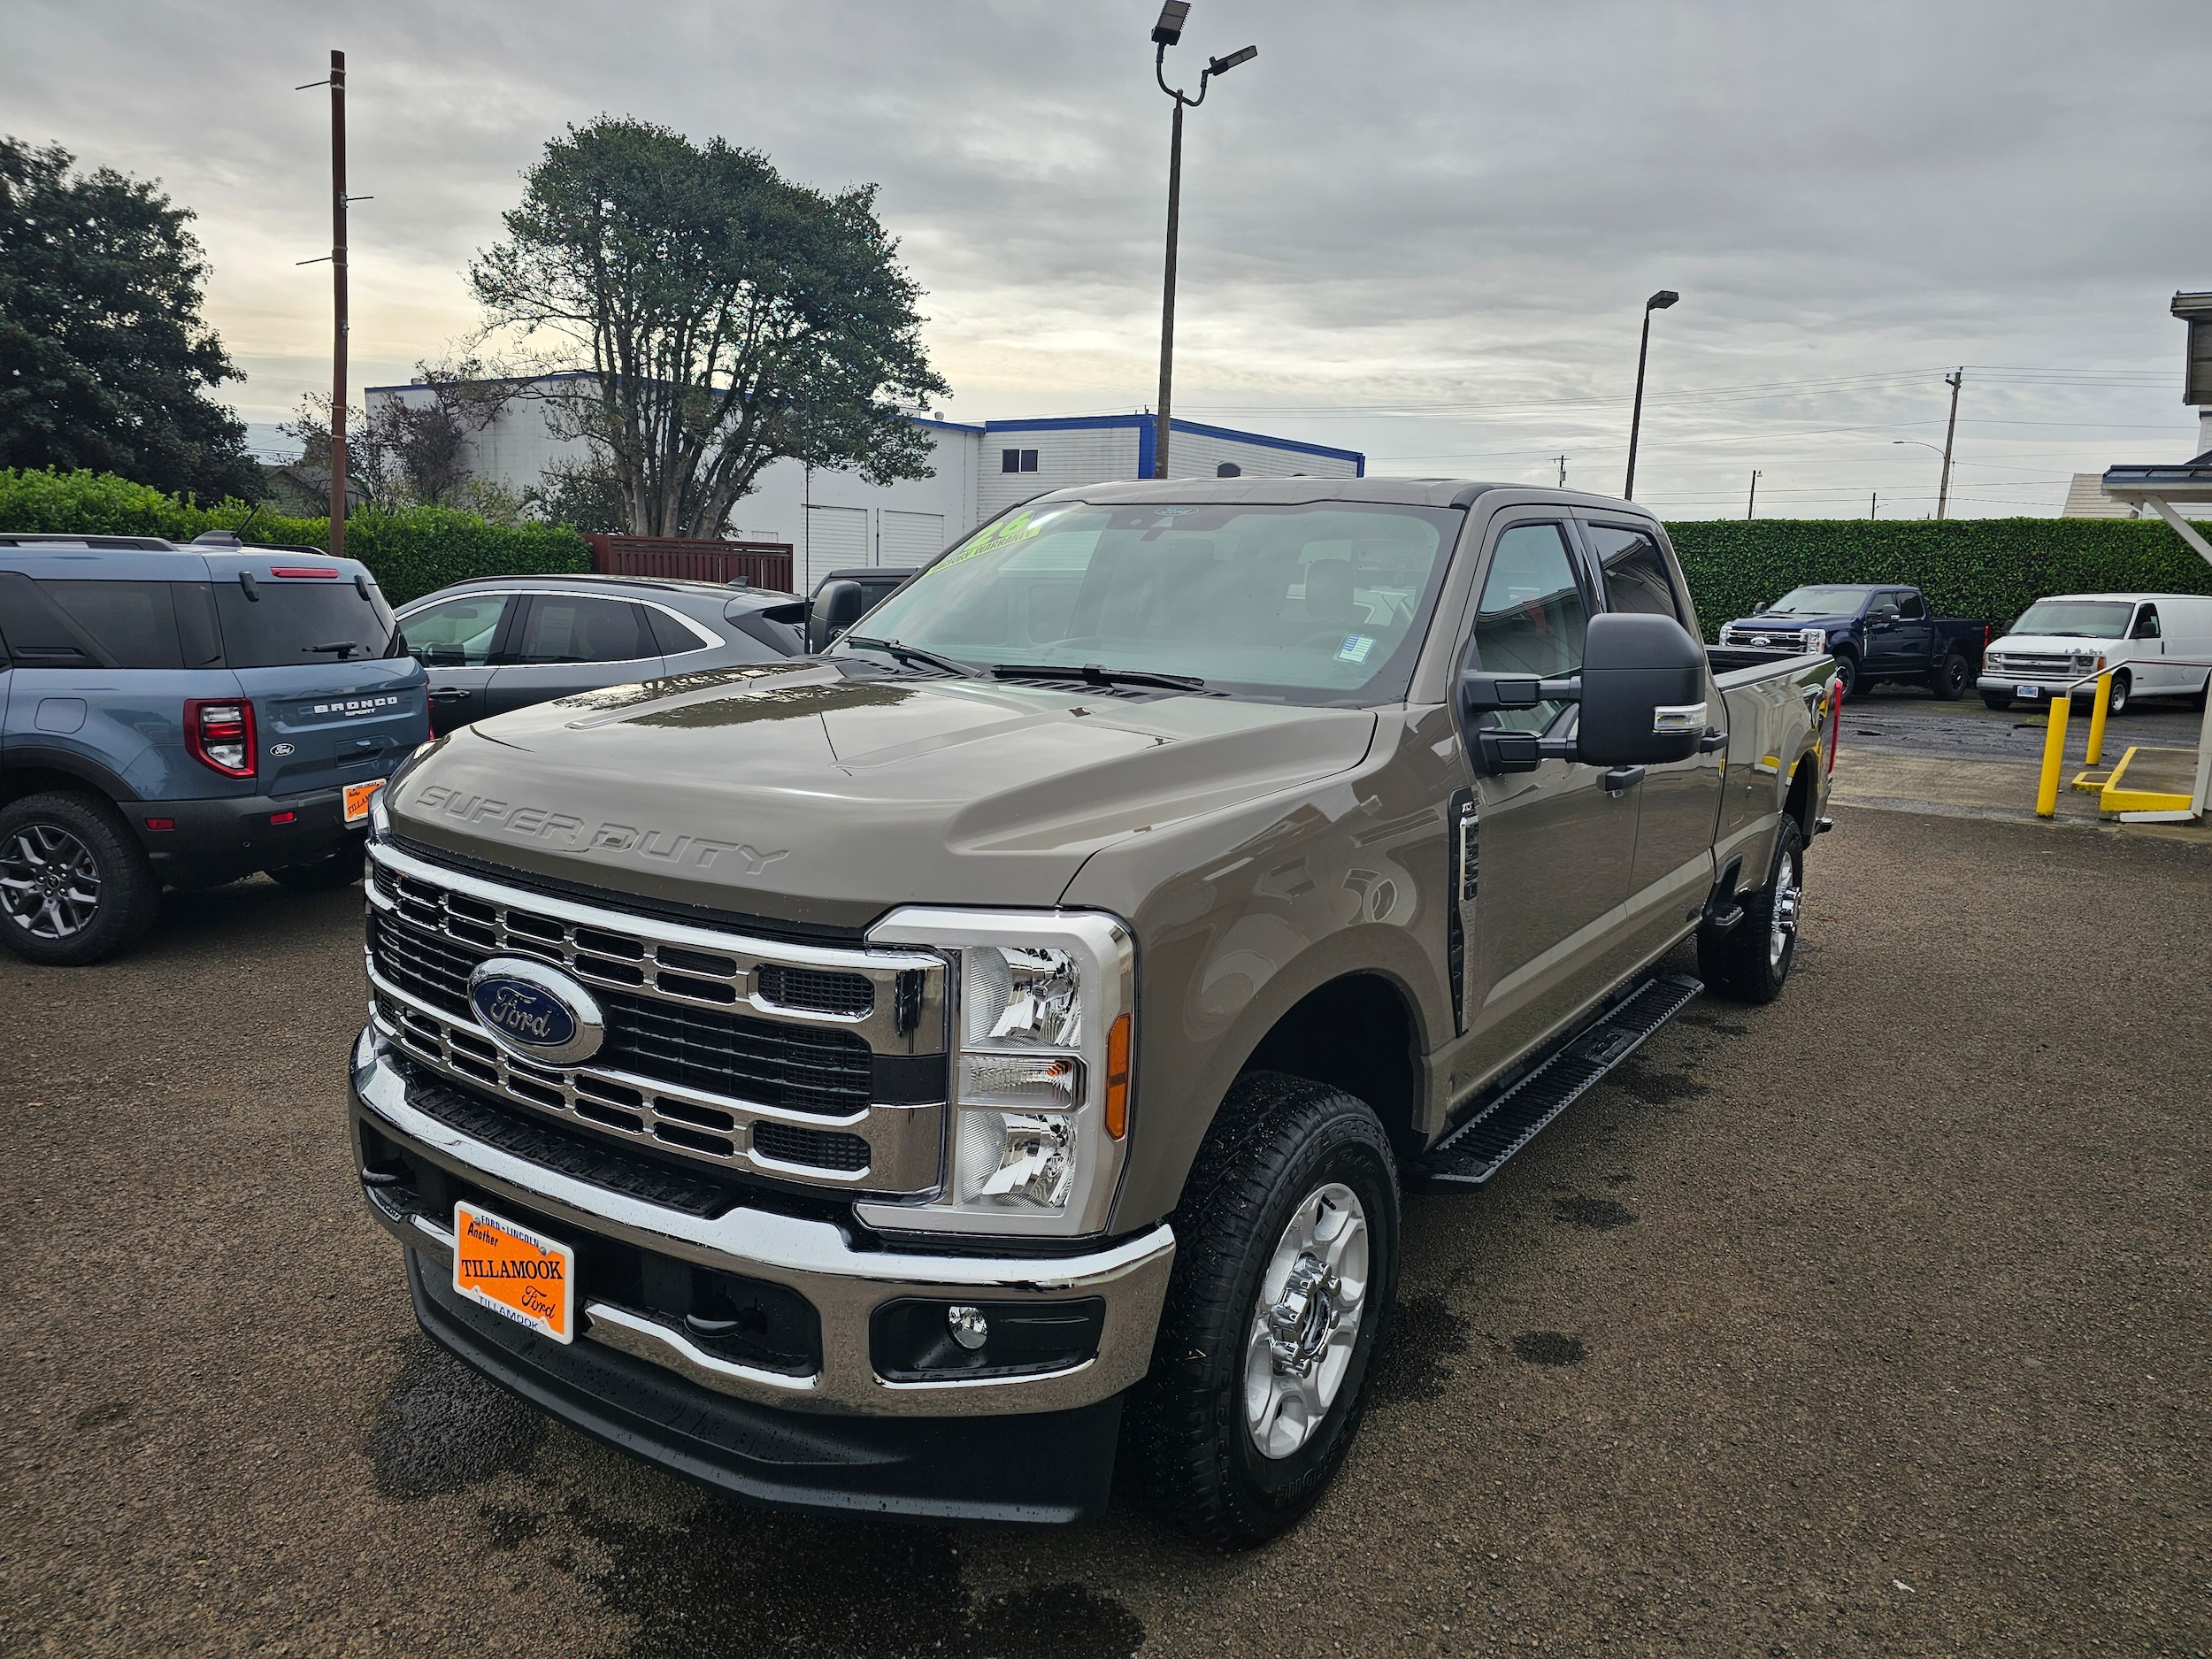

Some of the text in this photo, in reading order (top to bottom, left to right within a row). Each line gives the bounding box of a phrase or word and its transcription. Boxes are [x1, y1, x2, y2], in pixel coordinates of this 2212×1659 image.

[964, 510, 1035, 551] 26
[974, 529, 1033, 557] WARRANTY
[313, 696, 398, 714] BRONCO
[345, 708, 376, 717] SPORT
[414, 785, 792, 876] SUPER DUTY
[489, 986, 554, 1038] Ford
[467, 1222, 499, 1248] Another
[481, 1215, 540, 1248] FORD LINCOLN
[461, 1259, 564, 1280] TILLAMOOK
[479, 1295, 539, 1332] TILLAMOOK
[521, 1285, 557, 1319] Ford
